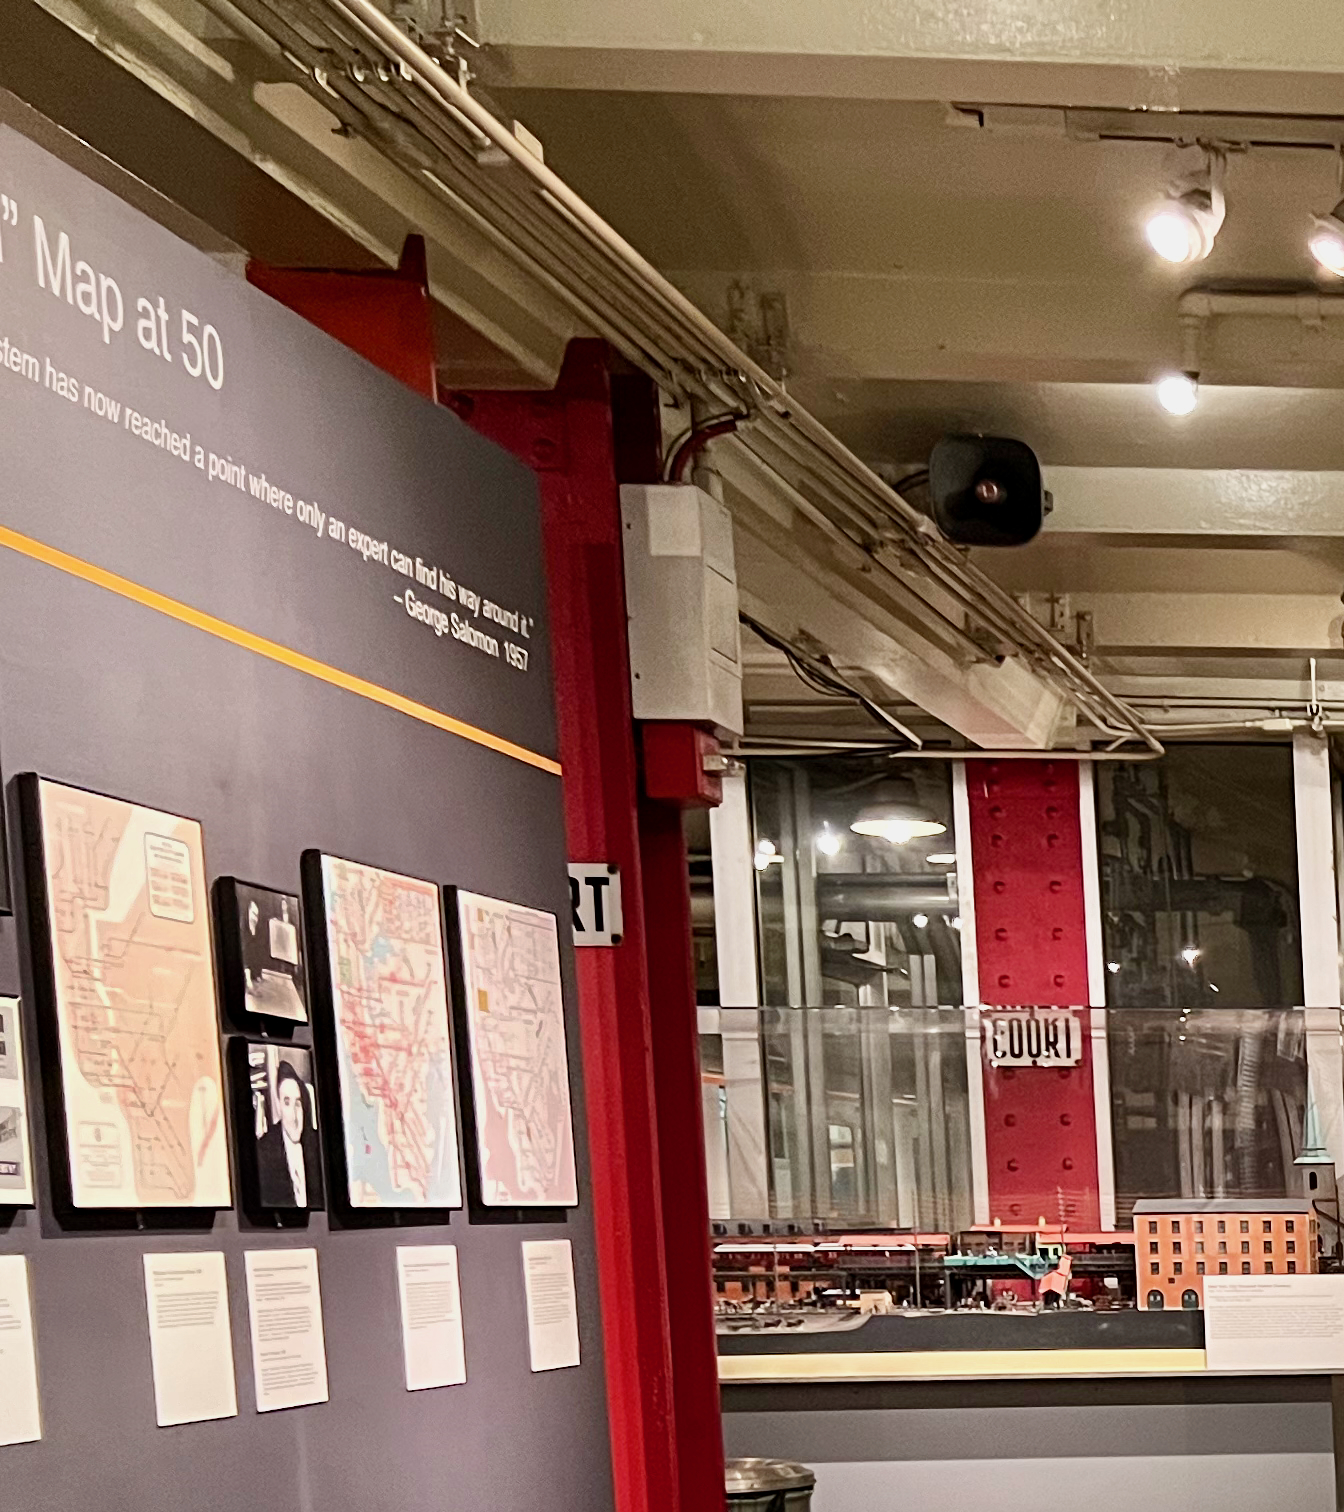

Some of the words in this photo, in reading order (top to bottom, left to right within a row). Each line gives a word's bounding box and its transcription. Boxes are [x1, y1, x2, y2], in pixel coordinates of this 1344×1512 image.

[34, 214, 124, 344] Map
[137, 296, 172, 362] at
[182, 309, 224, 390] 50
[45, 357, 78, 402] has
[84, 385, 121, 424] now
[125, 406, 190, 462] reached
[195, 445, 205, 470] a
[208, 452, 246, 491] point
[249, 473, 294, 515] where
[297, 500, 326, 537] only
[328, 516, 346, 543] an
[348, 528, 389, 566] expert
[390, 549, 414, 578] can
[415, 557, 438, 590] find
[439, 569, 457, 600] his
[457, 585, 481, 618] way
[482, 599, 519, 633] around
[404, 589, 449, 636] George
[450, 612, 499, 657] Salomon
[504, 641, 529, 671] 1957
